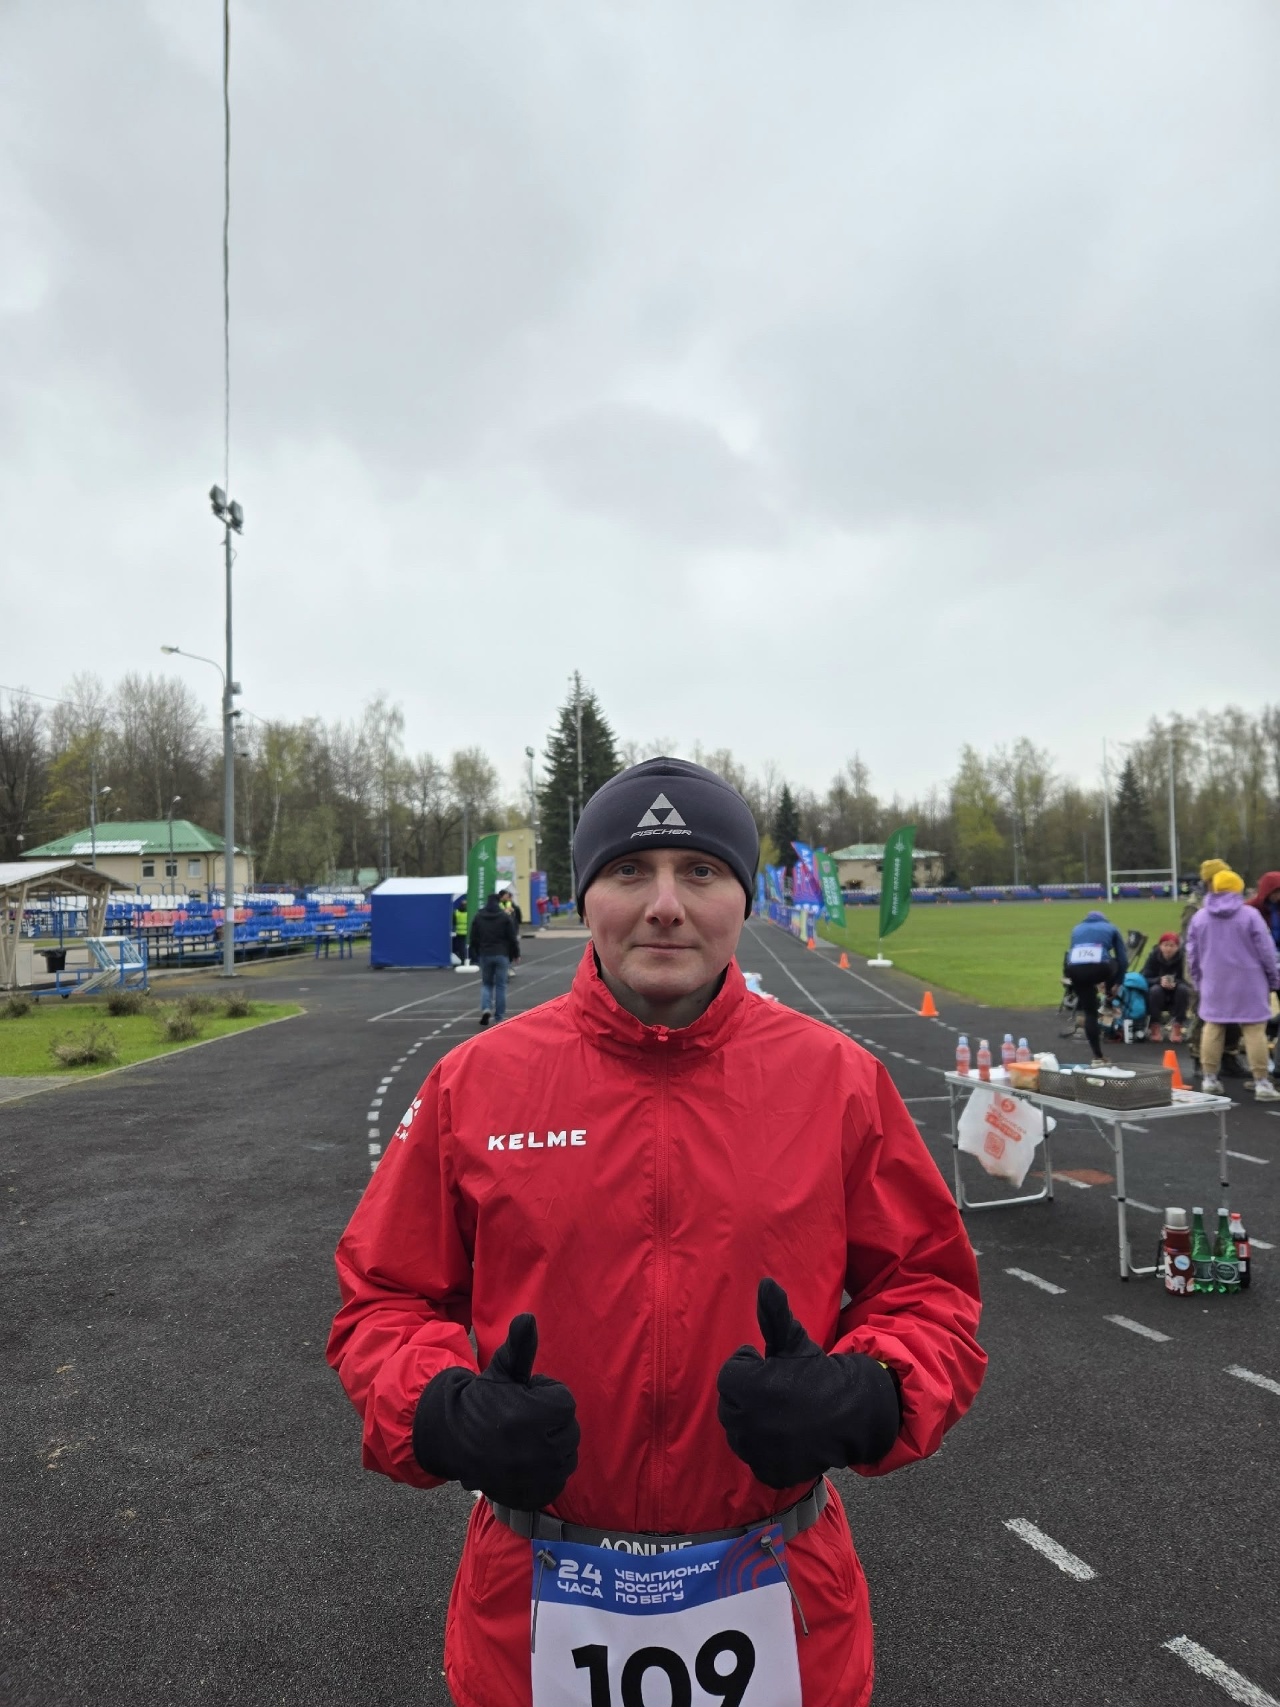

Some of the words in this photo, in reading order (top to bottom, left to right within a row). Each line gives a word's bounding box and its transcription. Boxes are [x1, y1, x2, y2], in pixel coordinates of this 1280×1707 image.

[630, 828, 692, 839] FISCHER
[488, 1129, 587, 1151] KELME
[558, 1559, 602, 1585] 24
[615, 1560, 720, 1581] ЧЕМПИОНАТ
[557, 1580, 603, 1598] ЧАСА
[615, 1579, 683, 1594] РОССИИ
[615, 1592, 639, 1604] ПО
[640, 1590, 684, 1604] БЕГУ
[571, 1629, 756, 1707] 109
